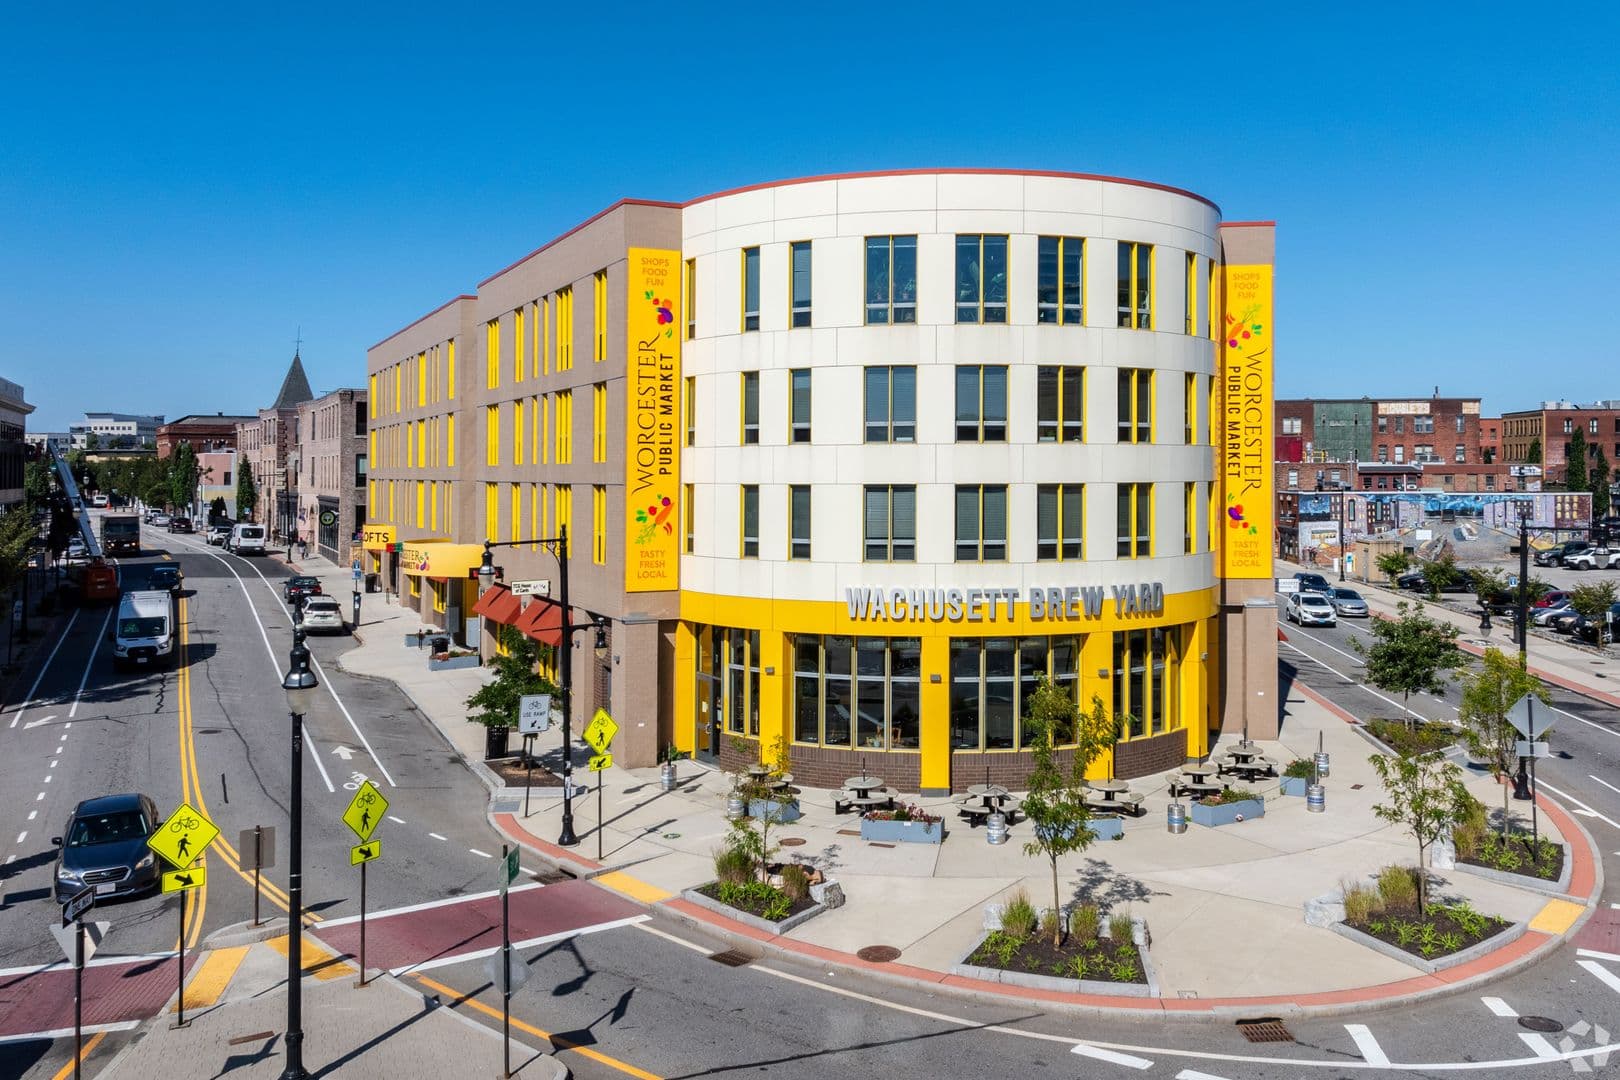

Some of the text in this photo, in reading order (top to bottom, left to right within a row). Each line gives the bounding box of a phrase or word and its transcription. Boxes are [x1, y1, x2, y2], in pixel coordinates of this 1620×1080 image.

[641, 258, 669, 266] SHOPS
[642, 268, 669, 276] FOOD
[646, 277, 665, 286] FUN
[1233, 273, 1260, 281] SHOPS
[631, 332, 660, 496] WORCESTER
[659, 353, 673, 476] PUBLIC MARKET
[1228, 366, 1241, 478] PUBLIC MARKET
[1241, 347, 1268, 496] WORCESTER
[1234, 541, 1259, 549] TASTY
[640, 550, 666, 559] TASTY
[1234, 550, 1259, 558] FRESH
[640, 560, 666, 569] FRESH
[1231, 559, 1261, 567] LOCAL
[637, 570, 667, 580] LOCAL
[846, 582, 1164, 623] WACHUSETT BREW YARD
